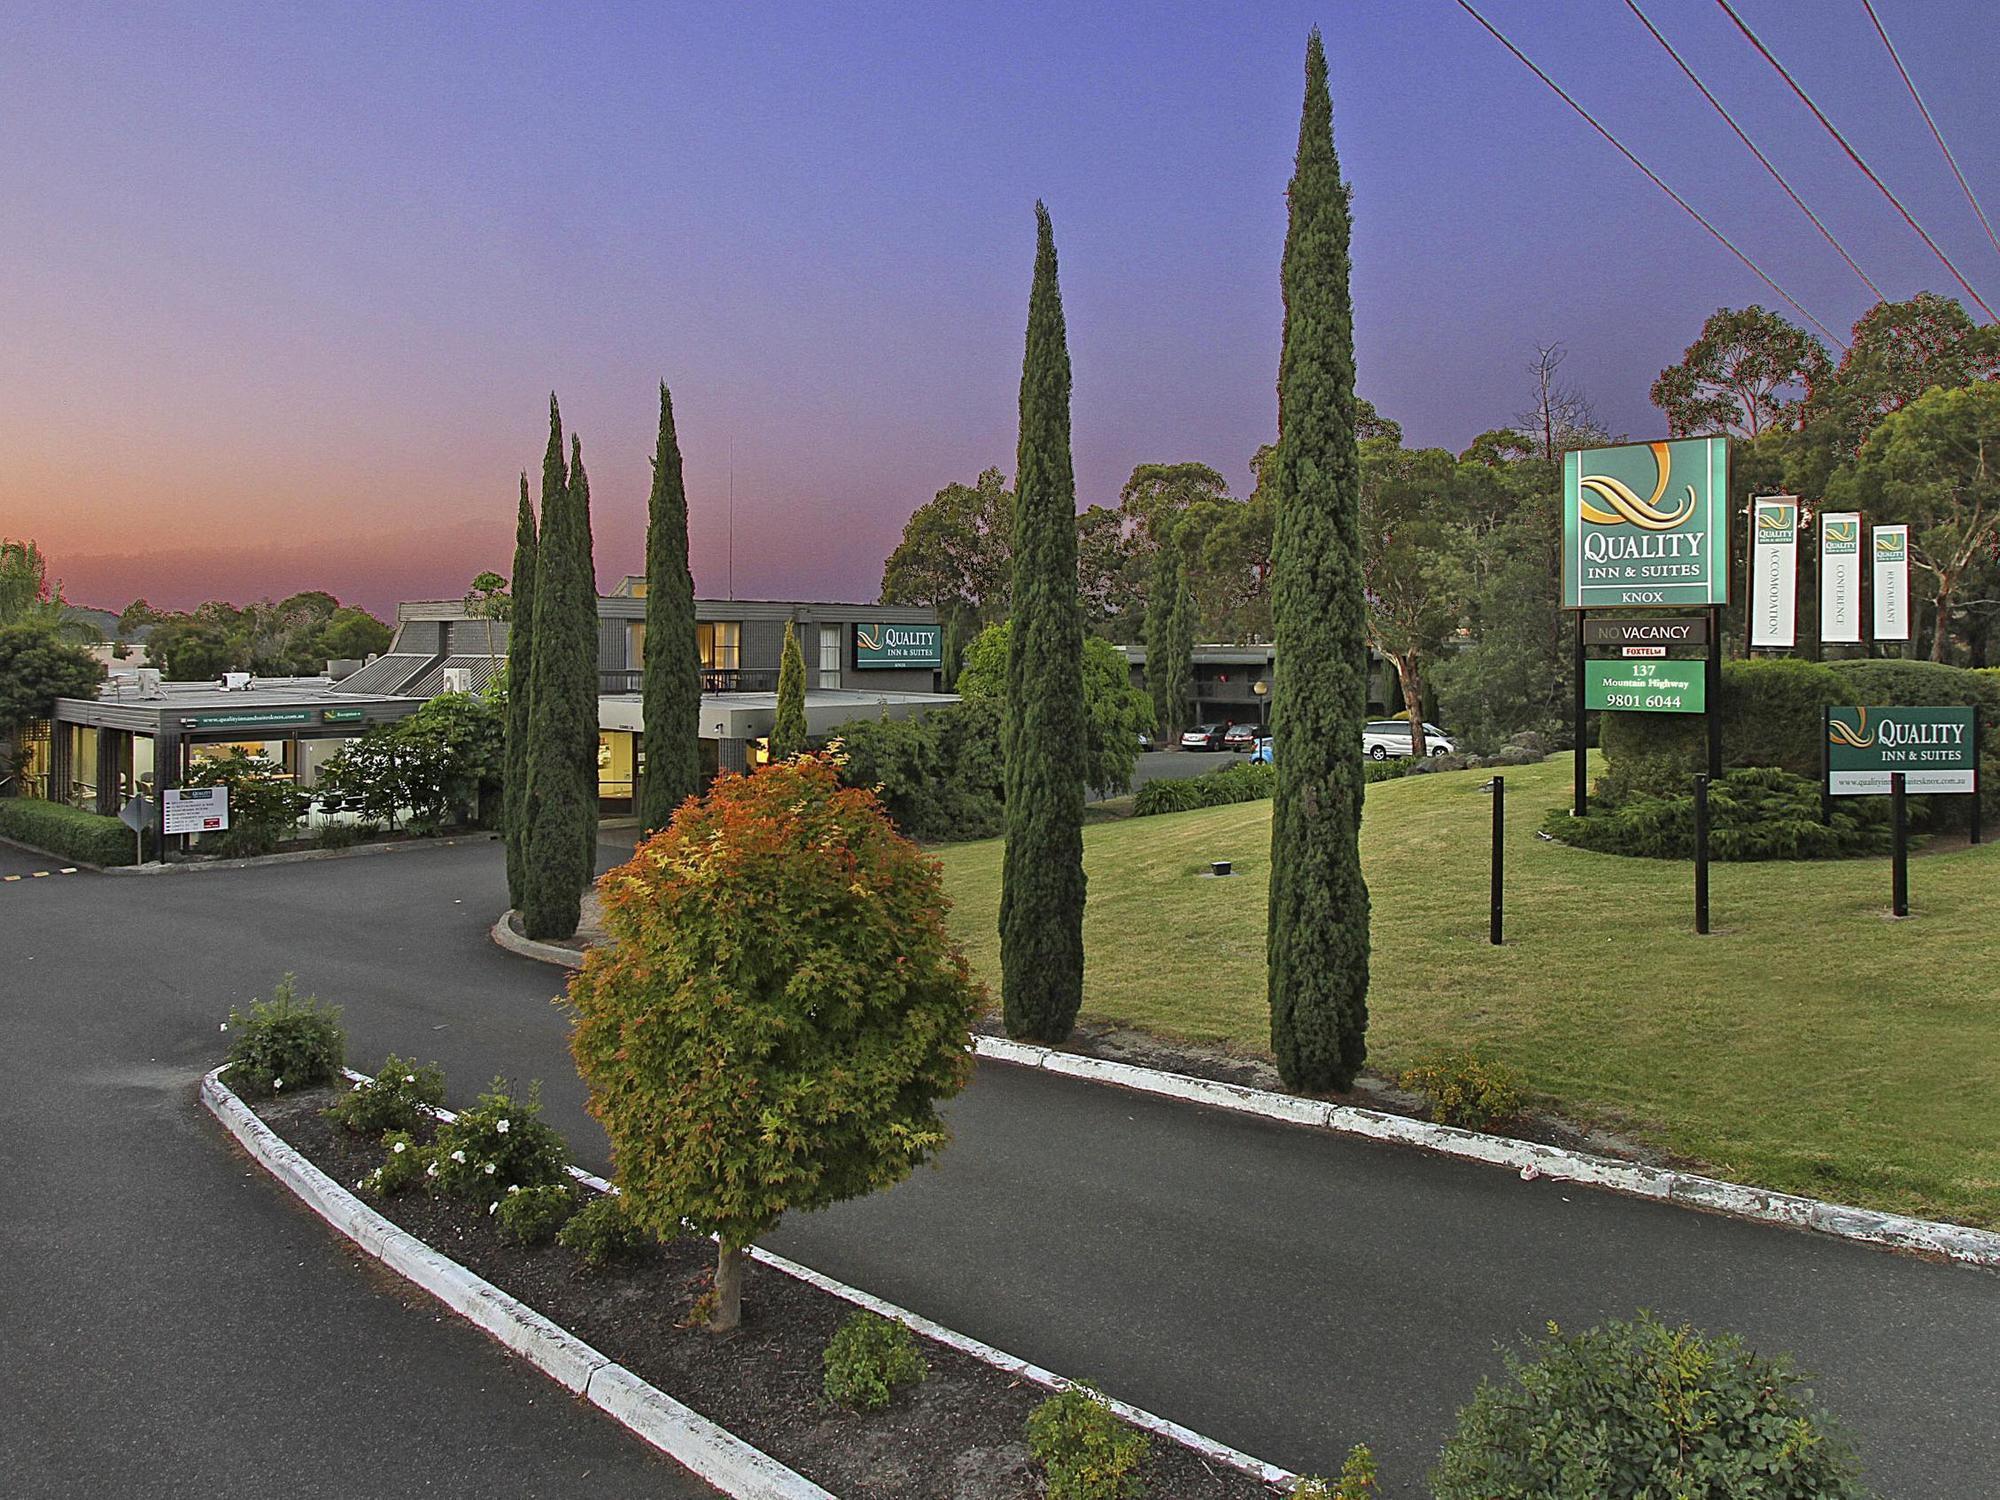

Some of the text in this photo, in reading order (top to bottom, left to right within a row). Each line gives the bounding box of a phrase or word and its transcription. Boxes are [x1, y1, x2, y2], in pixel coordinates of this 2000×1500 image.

[1759, 530, 1793, 539] QUALITY
[1583, 532, 1704, 563] QUALITY
[1587, 564, 1700, 579] INN & SUITES
[1621, 591, 1664, 603] KNOX
[885, 628, 935, 647] QUALITY
[1598, 625, 1690, 639] NO VACANCY
[1632, 665, 1656, 677] 137
[1602, 678, 1689, 690] Mountain Highway
[1606, 694, 1681, 708] 9801 6044
[1878, 719, 1965, 748] QUALITY
[1882, 751, 1962, 761] INN & SUITES
